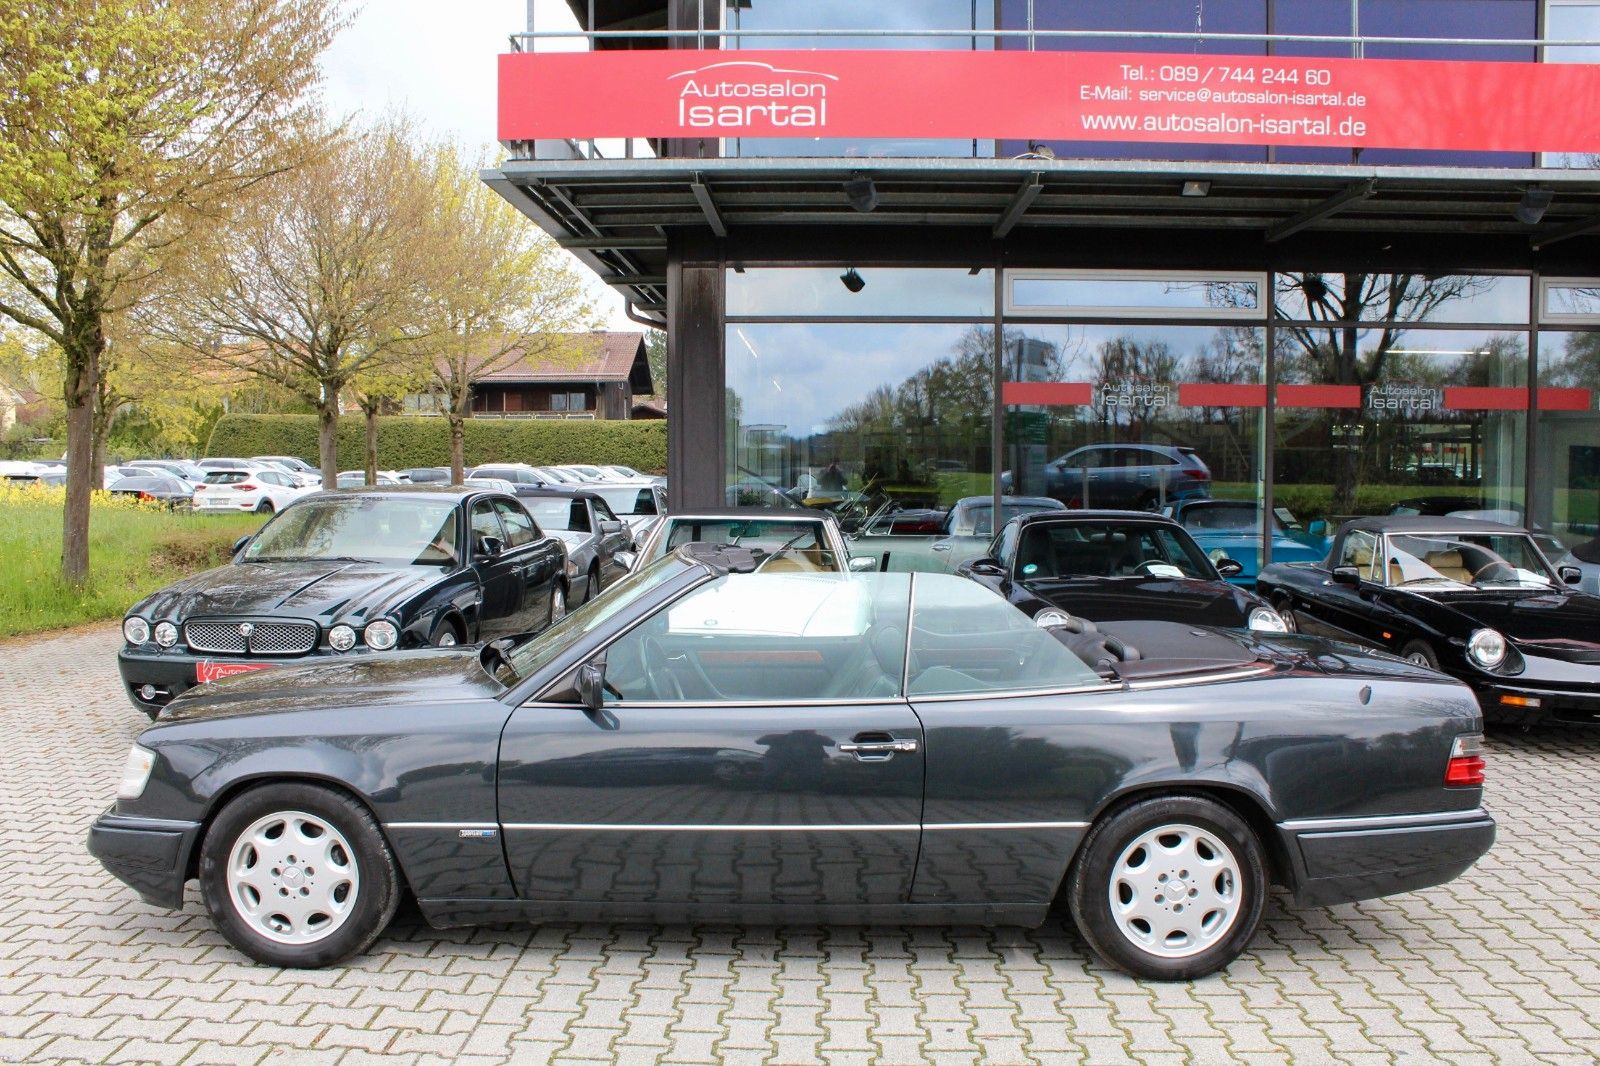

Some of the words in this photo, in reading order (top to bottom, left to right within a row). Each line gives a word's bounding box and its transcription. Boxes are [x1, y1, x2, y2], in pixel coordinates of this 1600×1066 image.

[1120, 64, 1154, 81] Tel.:
[1160, 65, 1199, 82] 089
[1201, 67, 1214, 84] /
[1218, 66, 1255, 83] 744
[1261, 68, 1299, 84] 244
[1305, 69, 1331, 86] 60
[680, 79, 826, 97] Autosalon
[1080, 85, 1132, 101] E-Mail:
[1139, 87, 1366, 107] service@autosalon-isartal.de
[679, 98, 826, 126] Isartal
[1081, 112, 1366, 137] www.autosalon-isartal.de
[1102, 382, 1170, 392] Autosalon
[1370, 385, 1436, 395] Autosalon
[1101, 391, 1170, 406] Isartal
[1369, 394, 1436, 409] Isartal
